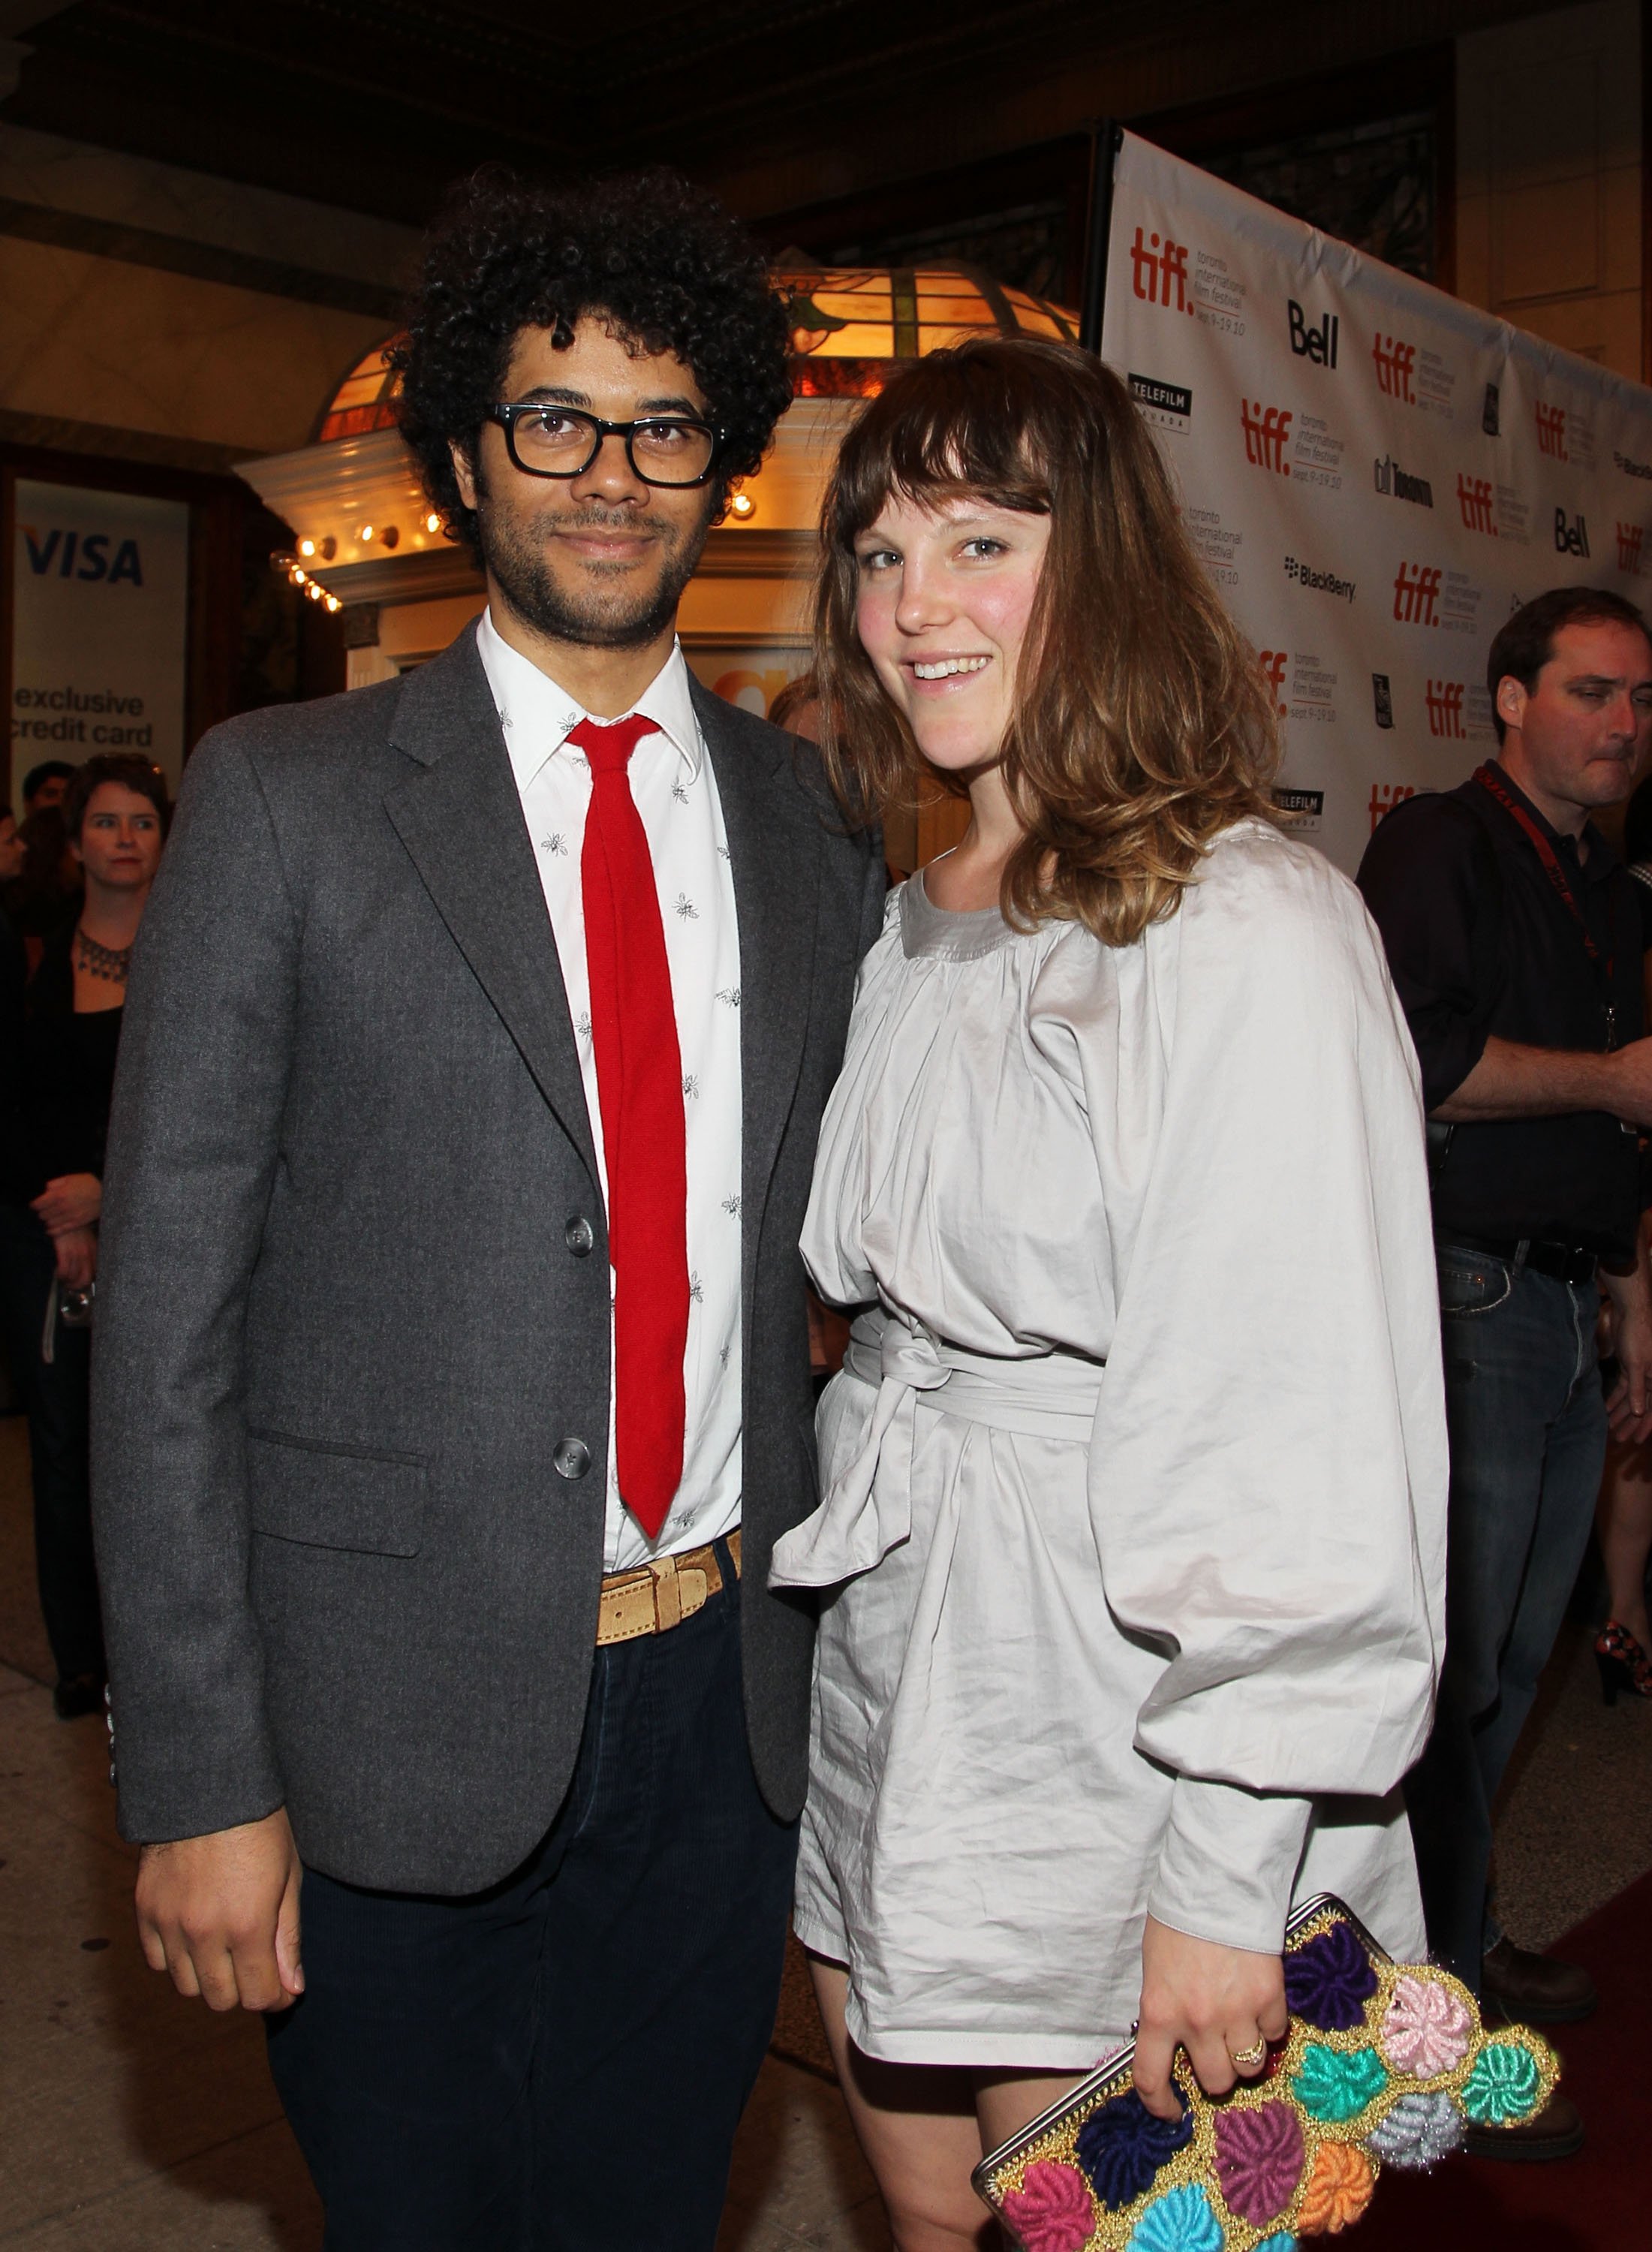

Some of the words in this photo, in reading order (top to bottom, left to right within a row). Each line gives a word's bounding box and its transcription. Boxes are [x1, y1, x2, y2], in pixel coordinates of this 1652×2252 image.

[1130, 227, 1194, 316] tiff.
[1288, 299, 1338, 369] Bell
[1372, 333, 1416, 405] tiff.
[1133, 381, 1185, 409] TELEFILM
[1142, 410, 1184, 427] ANADA
[1241, 398, 1292, 476] tiff.
[1295, 442, 1311, 457] film
[1189, 507, 1220, 525] toronto
[1457, 473, 1498, 537] tiff.
[1205, 541, 1235, 559] festival
[1554, 507, 1590, 558] Bell
[18, 525, 143, 587] VISA
[1300, 565, 1356, 604] BlackBerry
[1394, 561, 1442, 627] tiff.
[15, 686, 144, 716] exclusive
[1425, 679, 1467, 739] tiff.
[10, 716, 86, 743] credit
[92, 722, 153, 747] card
[1280, 795, 1318, 810] ELEFILM
